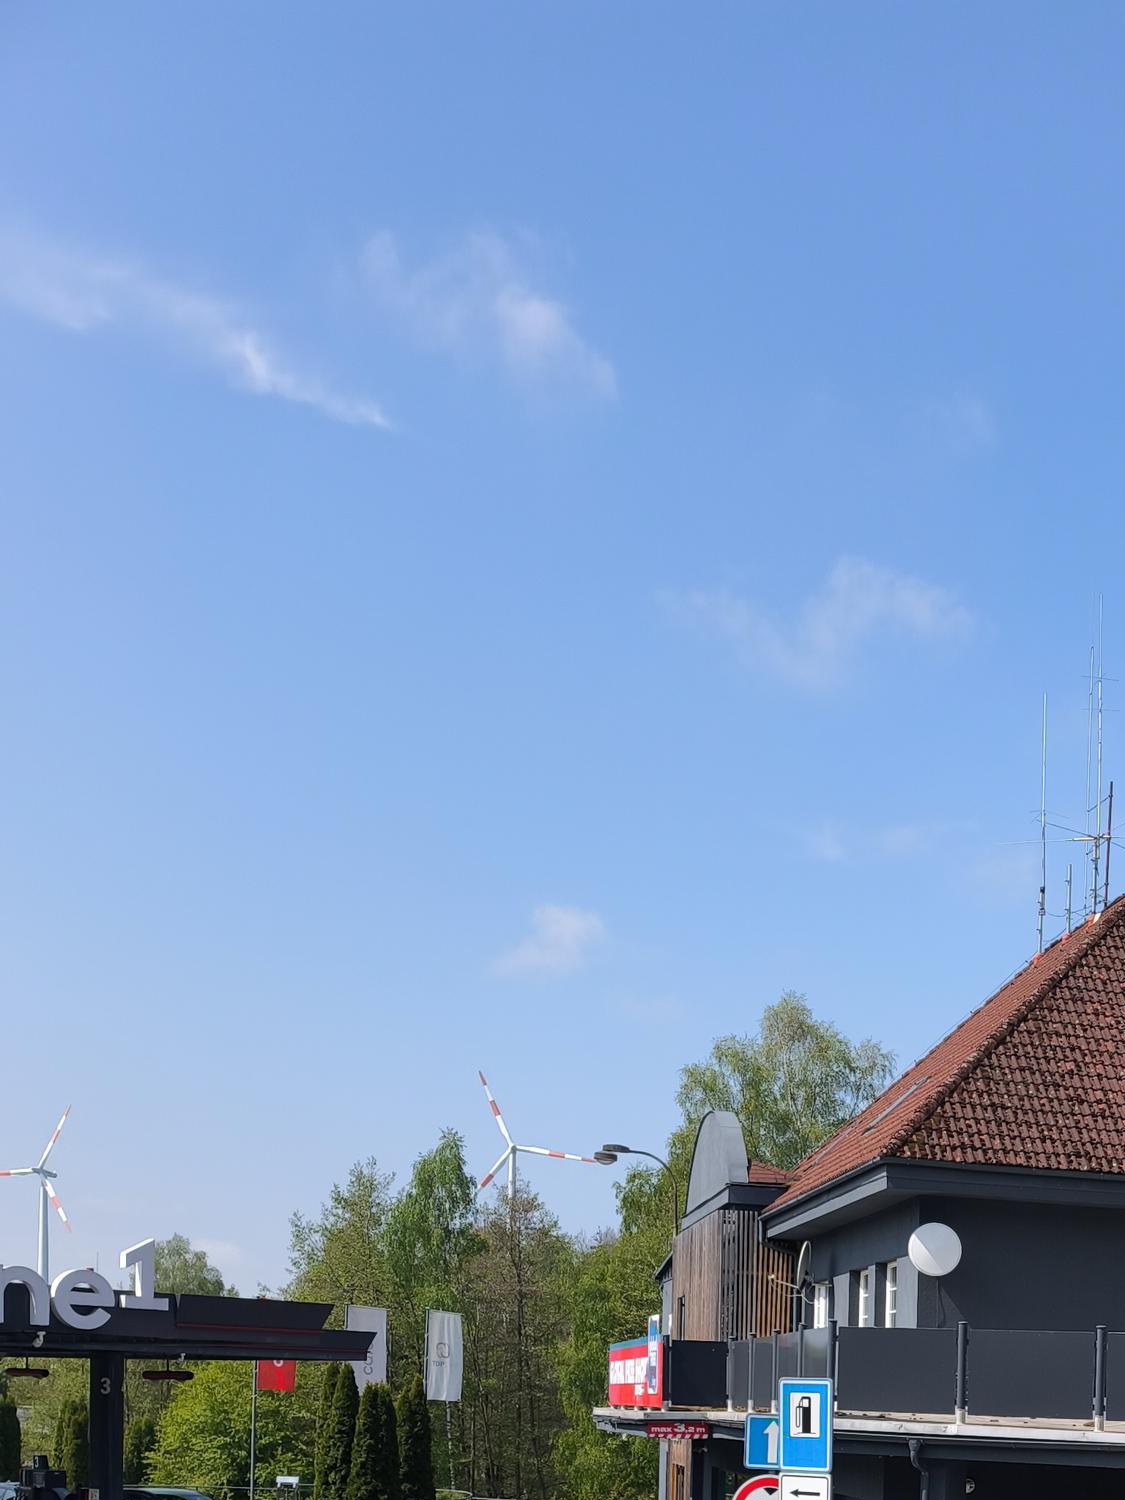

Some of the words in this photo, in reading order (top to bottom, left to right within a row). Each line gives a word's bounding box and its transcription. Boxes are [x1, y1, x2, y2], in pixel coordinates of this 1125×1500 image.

[100, 1377, 111, 1395] 3
[673, 1422, 695, 1434] 3,2
[34, 1456, 39, 1468] 3
